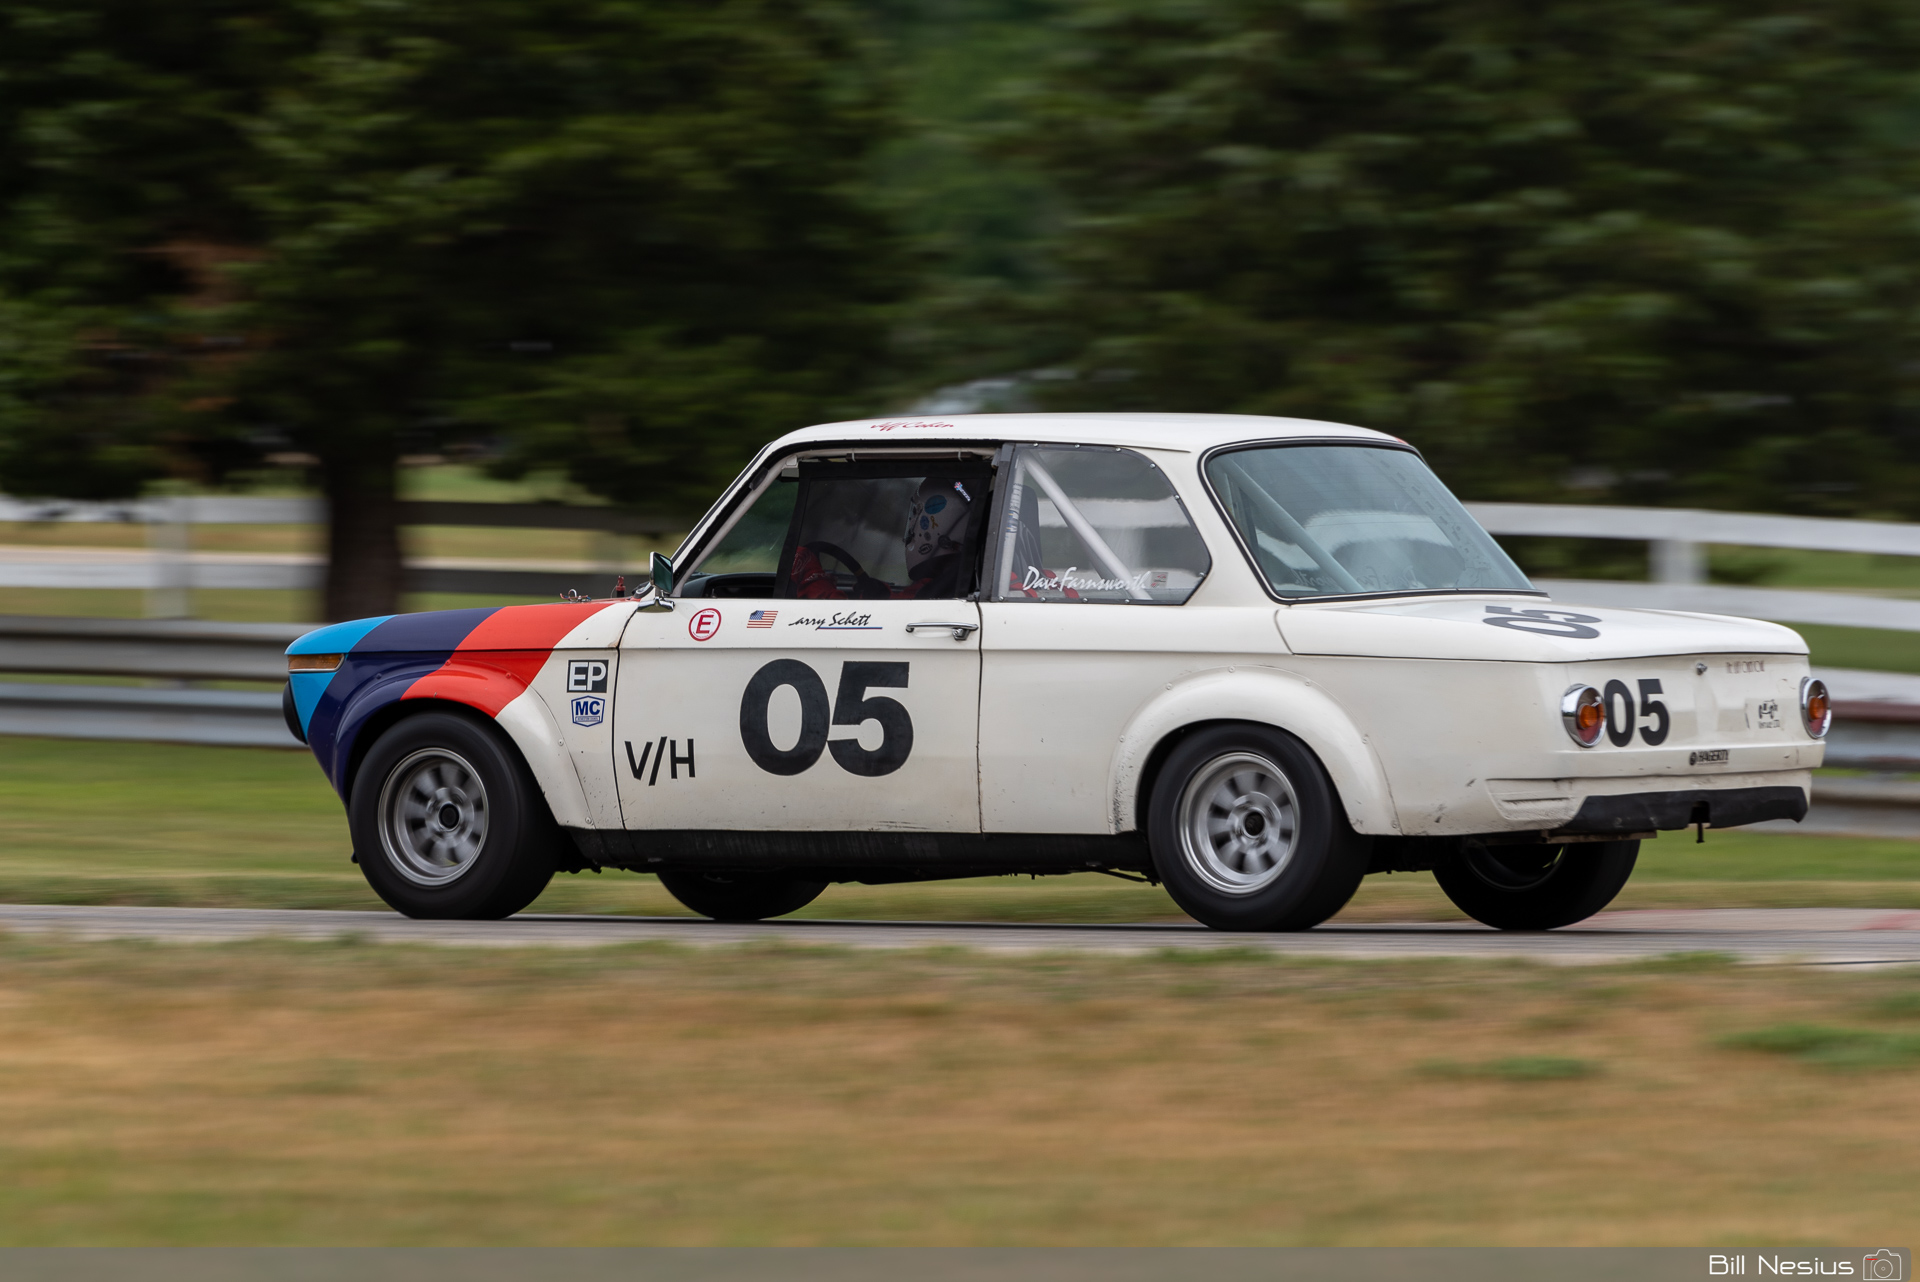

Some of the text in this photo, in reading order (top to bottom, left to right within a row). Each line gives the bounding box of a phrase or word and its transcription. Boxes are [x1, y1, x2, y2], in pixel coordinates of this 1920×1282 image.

[1022, 565, 1151, 592] Dave Farnsworth
[695, 614, 715, 634] E
[1482, 605, 1603, 639] 05
[568, 661, 607, 691] EP
[575, 700, 601, 716] MC
[739, 658, 914, 777] 05
[1604, 678, 1670, 748] 05
[624, 736, 696, 787] V/H
